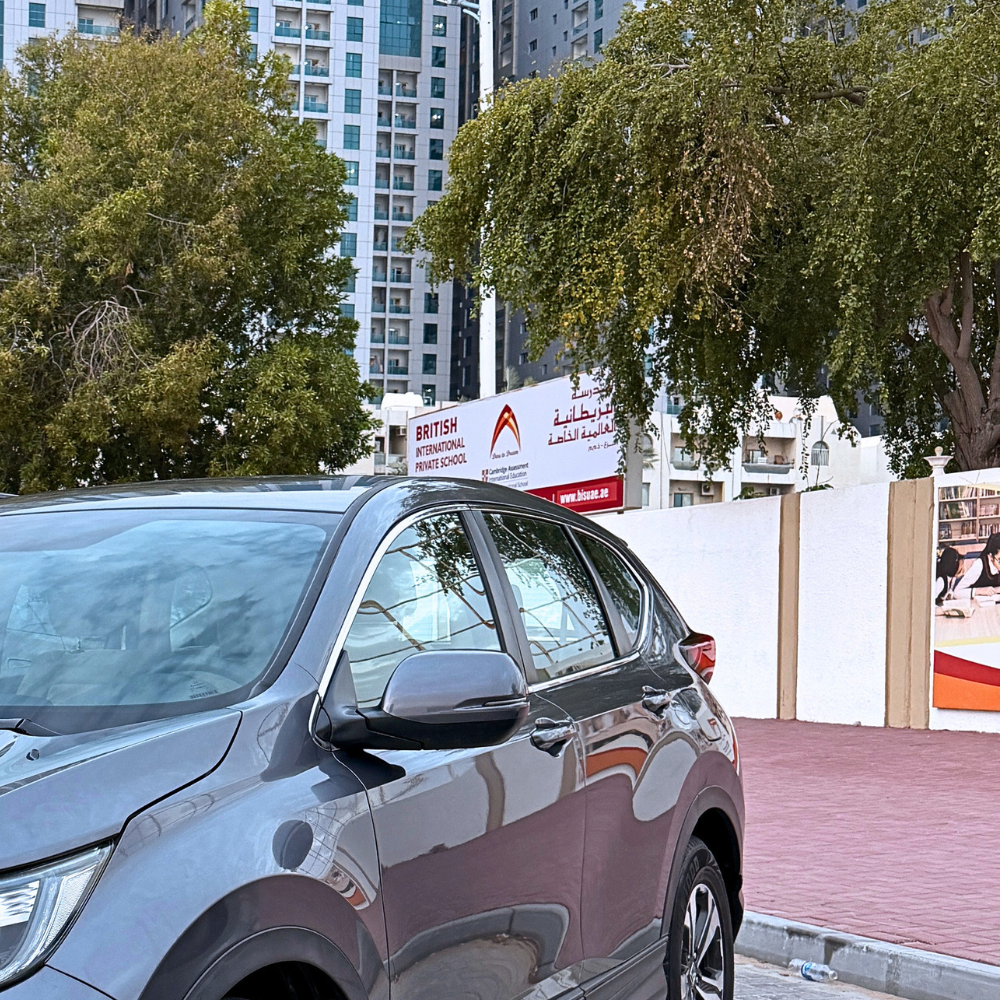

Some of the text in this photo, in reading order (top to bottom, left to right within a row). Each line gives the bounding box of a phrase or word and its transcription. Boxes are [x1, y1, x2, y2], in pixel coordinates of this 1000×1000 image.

[416, 416, 458, 442] BRITISH
[415, 437, 465, 457] INTERNATIONAL
[415, 453, 467, 473] PRIVATE SCHOOL
[489, 462, 529, 475] Cambridge Assessment
[510, 471, 527, 479] Education
[560, 487, 609, 504] www.bisuae.ae
